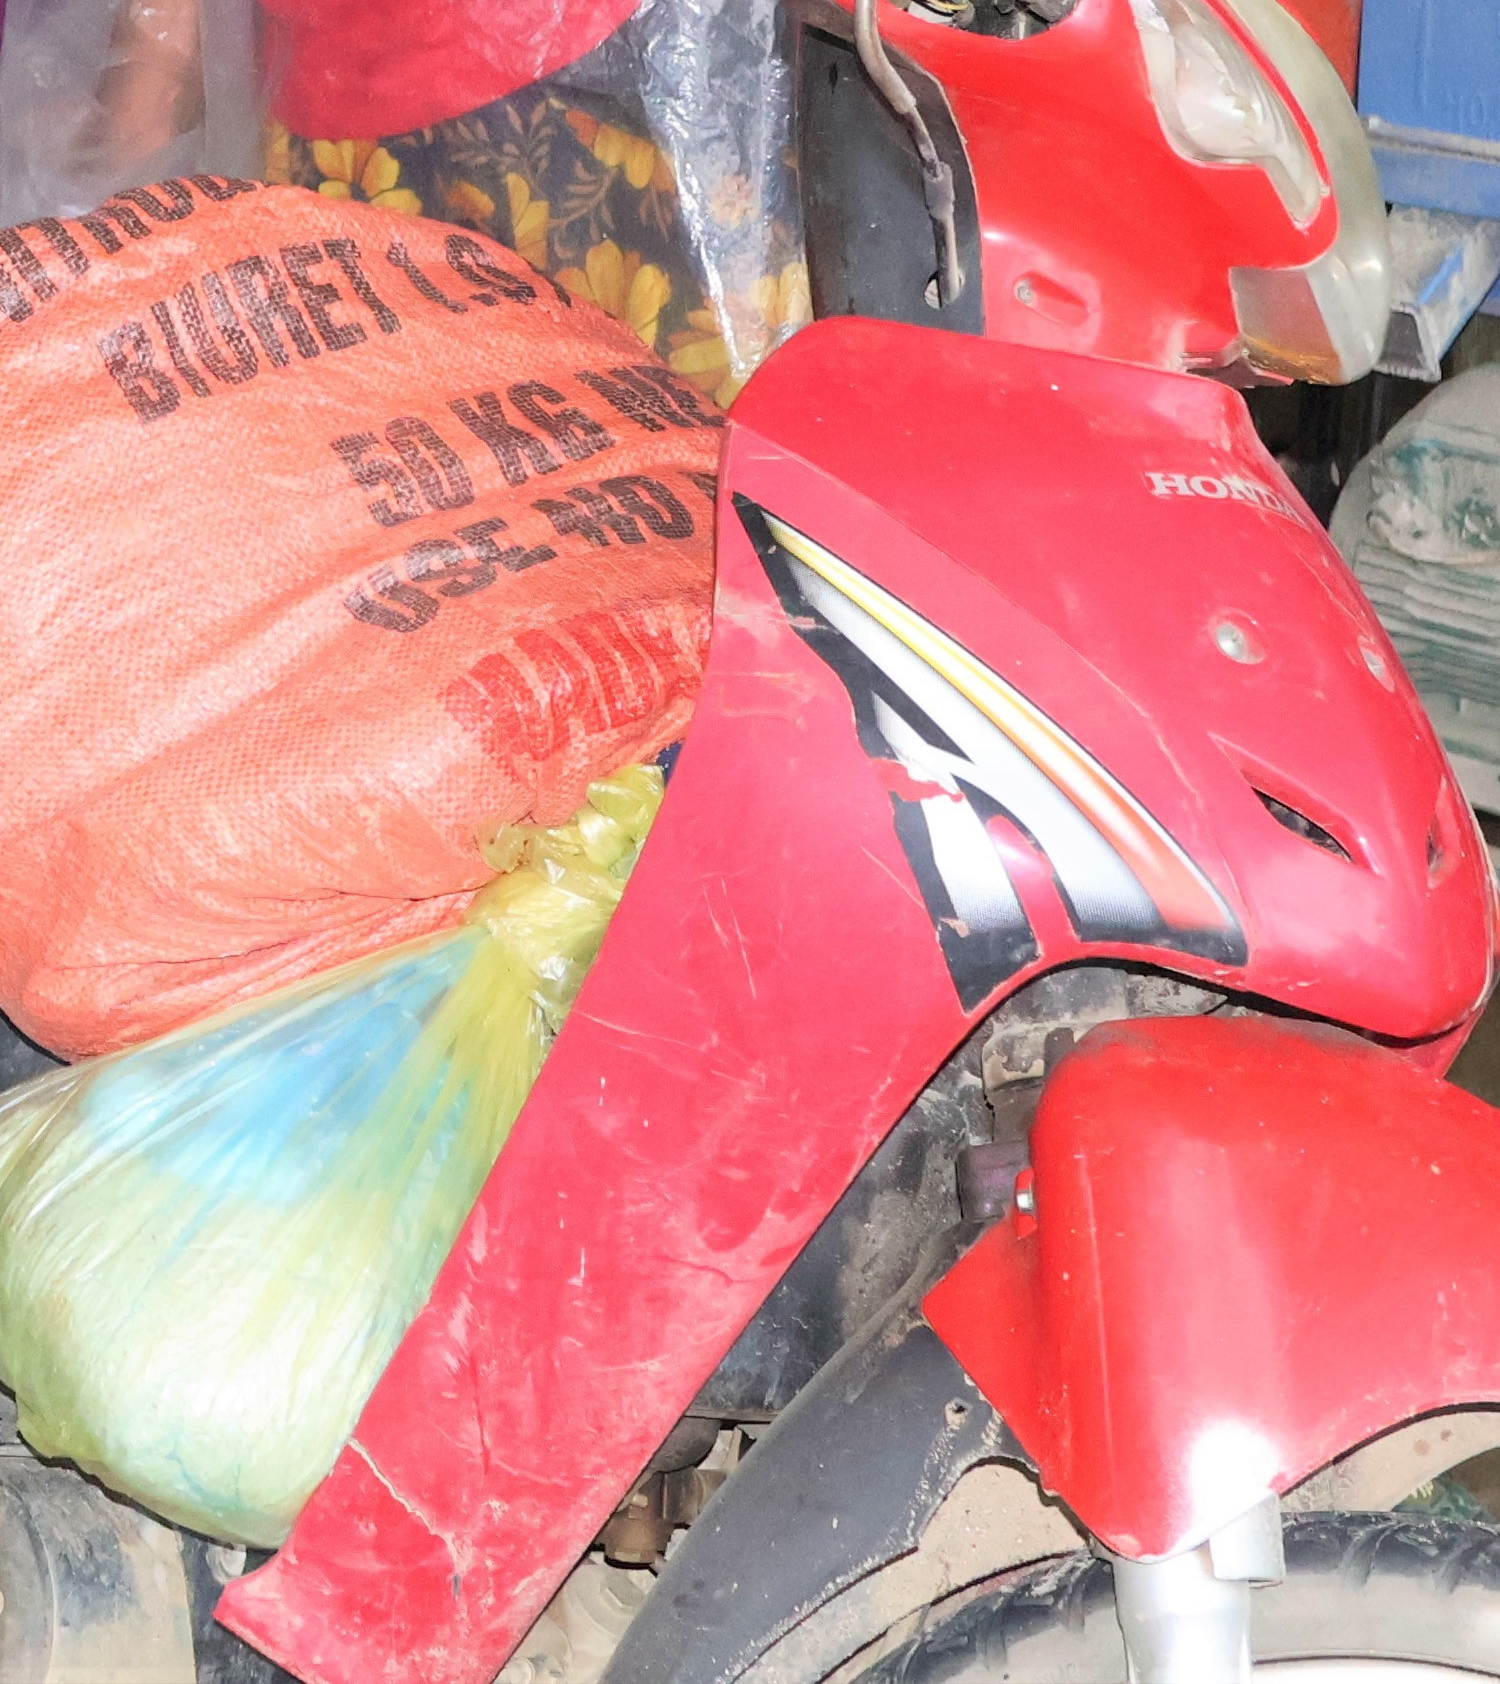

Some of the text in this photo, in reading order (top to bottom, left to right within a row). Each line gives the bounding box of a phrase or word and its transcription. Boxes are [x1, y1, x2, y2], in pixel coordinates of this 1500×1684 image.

[98, 237, 402, 424] BIURET
[331, 416, 476, 528] 50
[445, 378, 617, 488] KG
[1144, 471, 1310, 526] HONDA
[341, 517, 558, 633] USE
